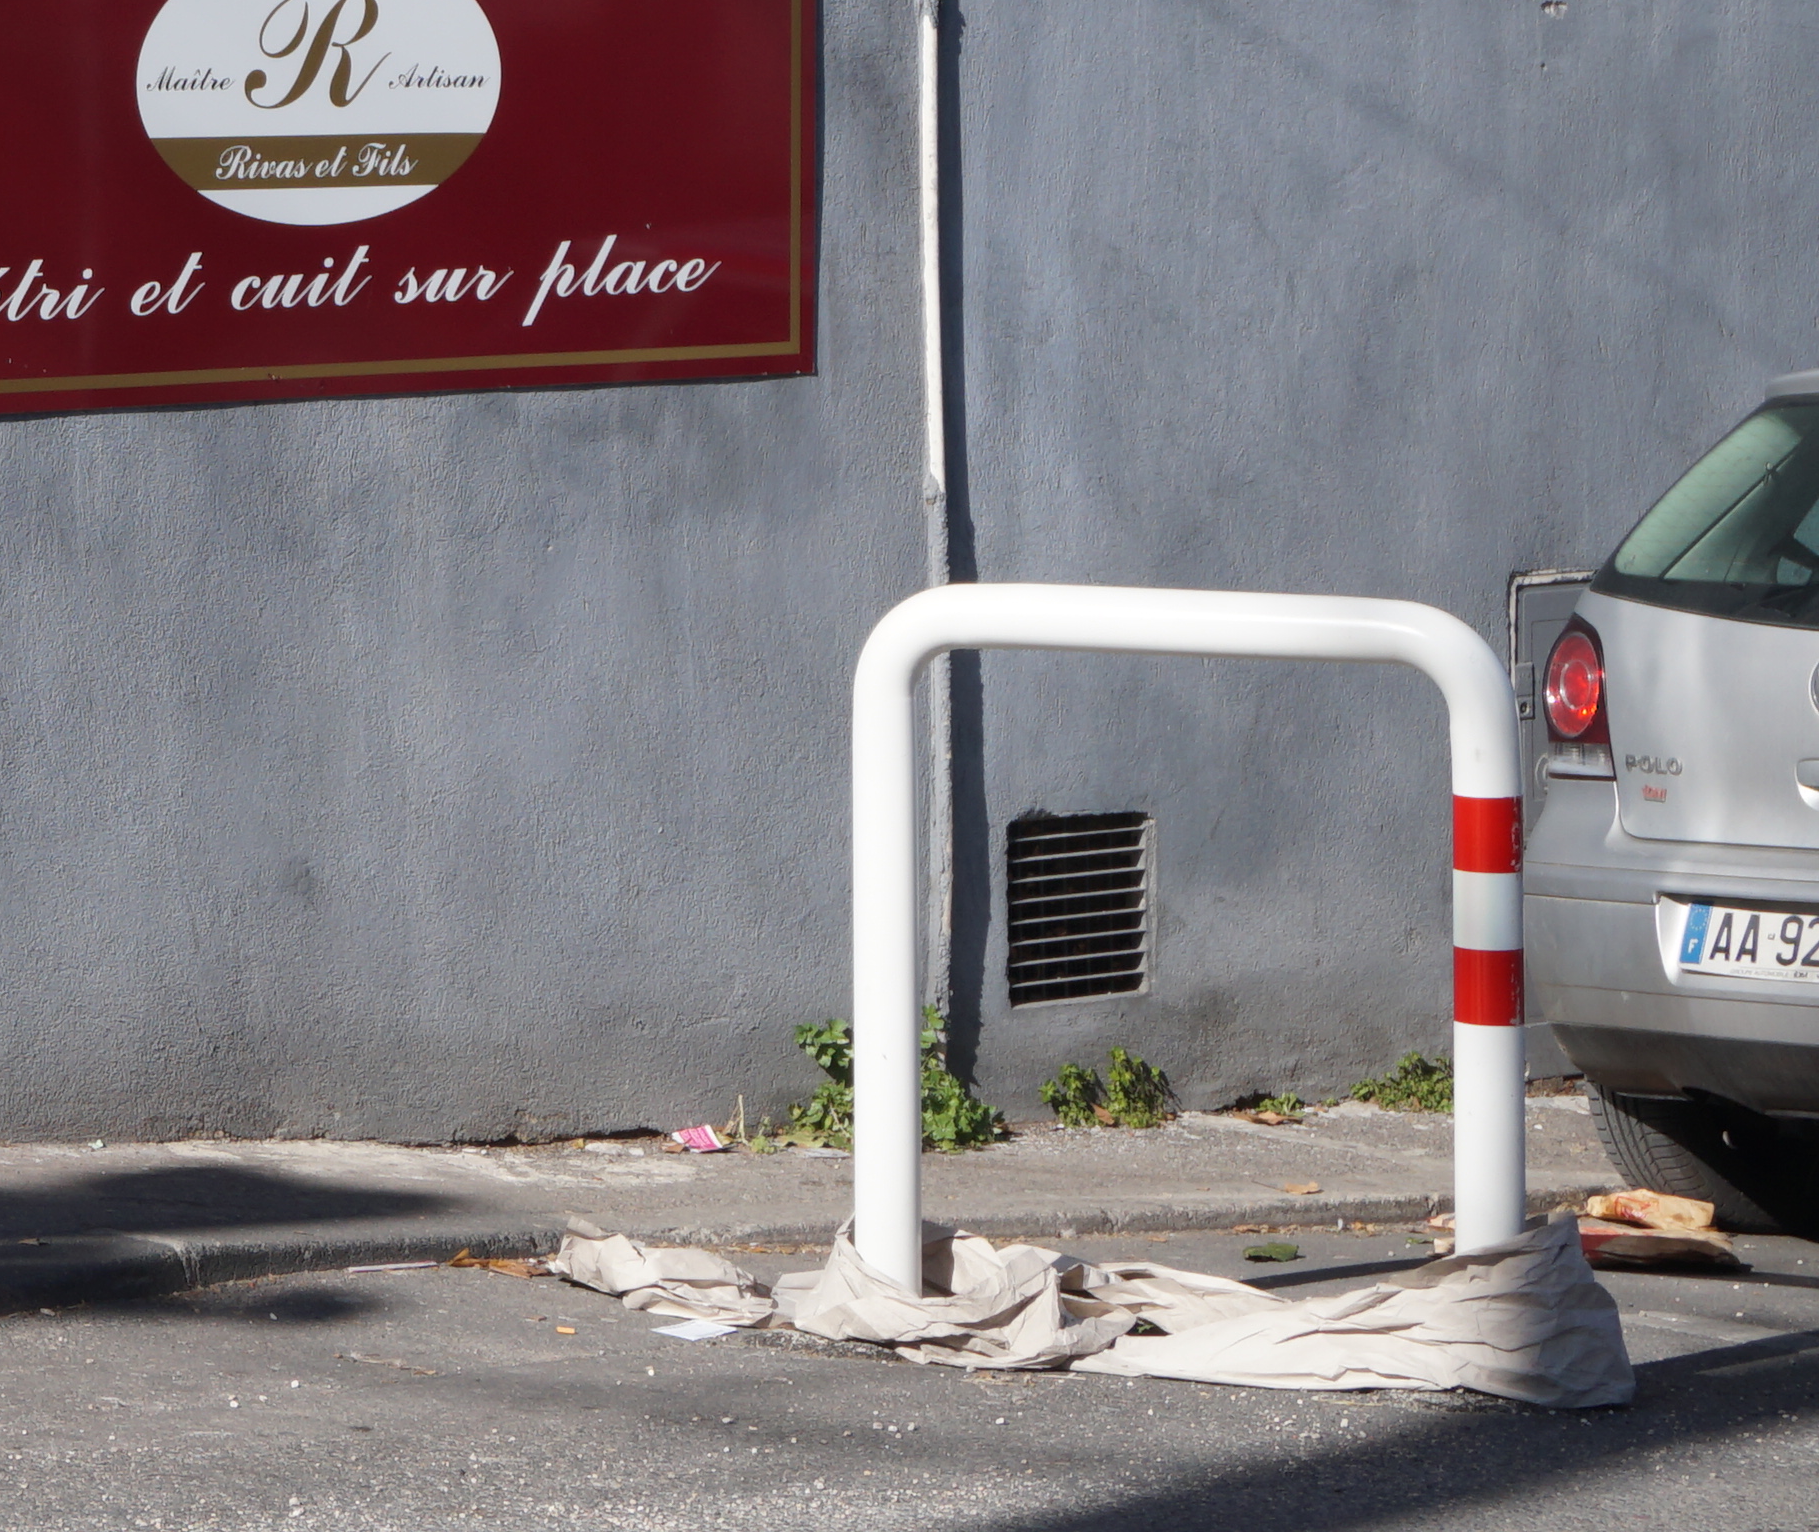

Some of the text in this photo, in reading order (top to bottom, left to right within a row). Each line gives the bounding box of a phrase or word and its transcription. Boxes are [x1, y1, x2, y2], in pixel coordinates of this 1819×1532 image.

[146, 62, 490, 92] Maître Artisan
[215, 143, 419, 180] Rivas et Fils
[129, 250, 206, 317] et
[230, 244, 373, 310] cuit
[393, 265, 514, 306] sur
[522, 233, 721, 326] place
[1625, 754, 1683, 776] POLO
[1709, 912, 1761, 963] AA
